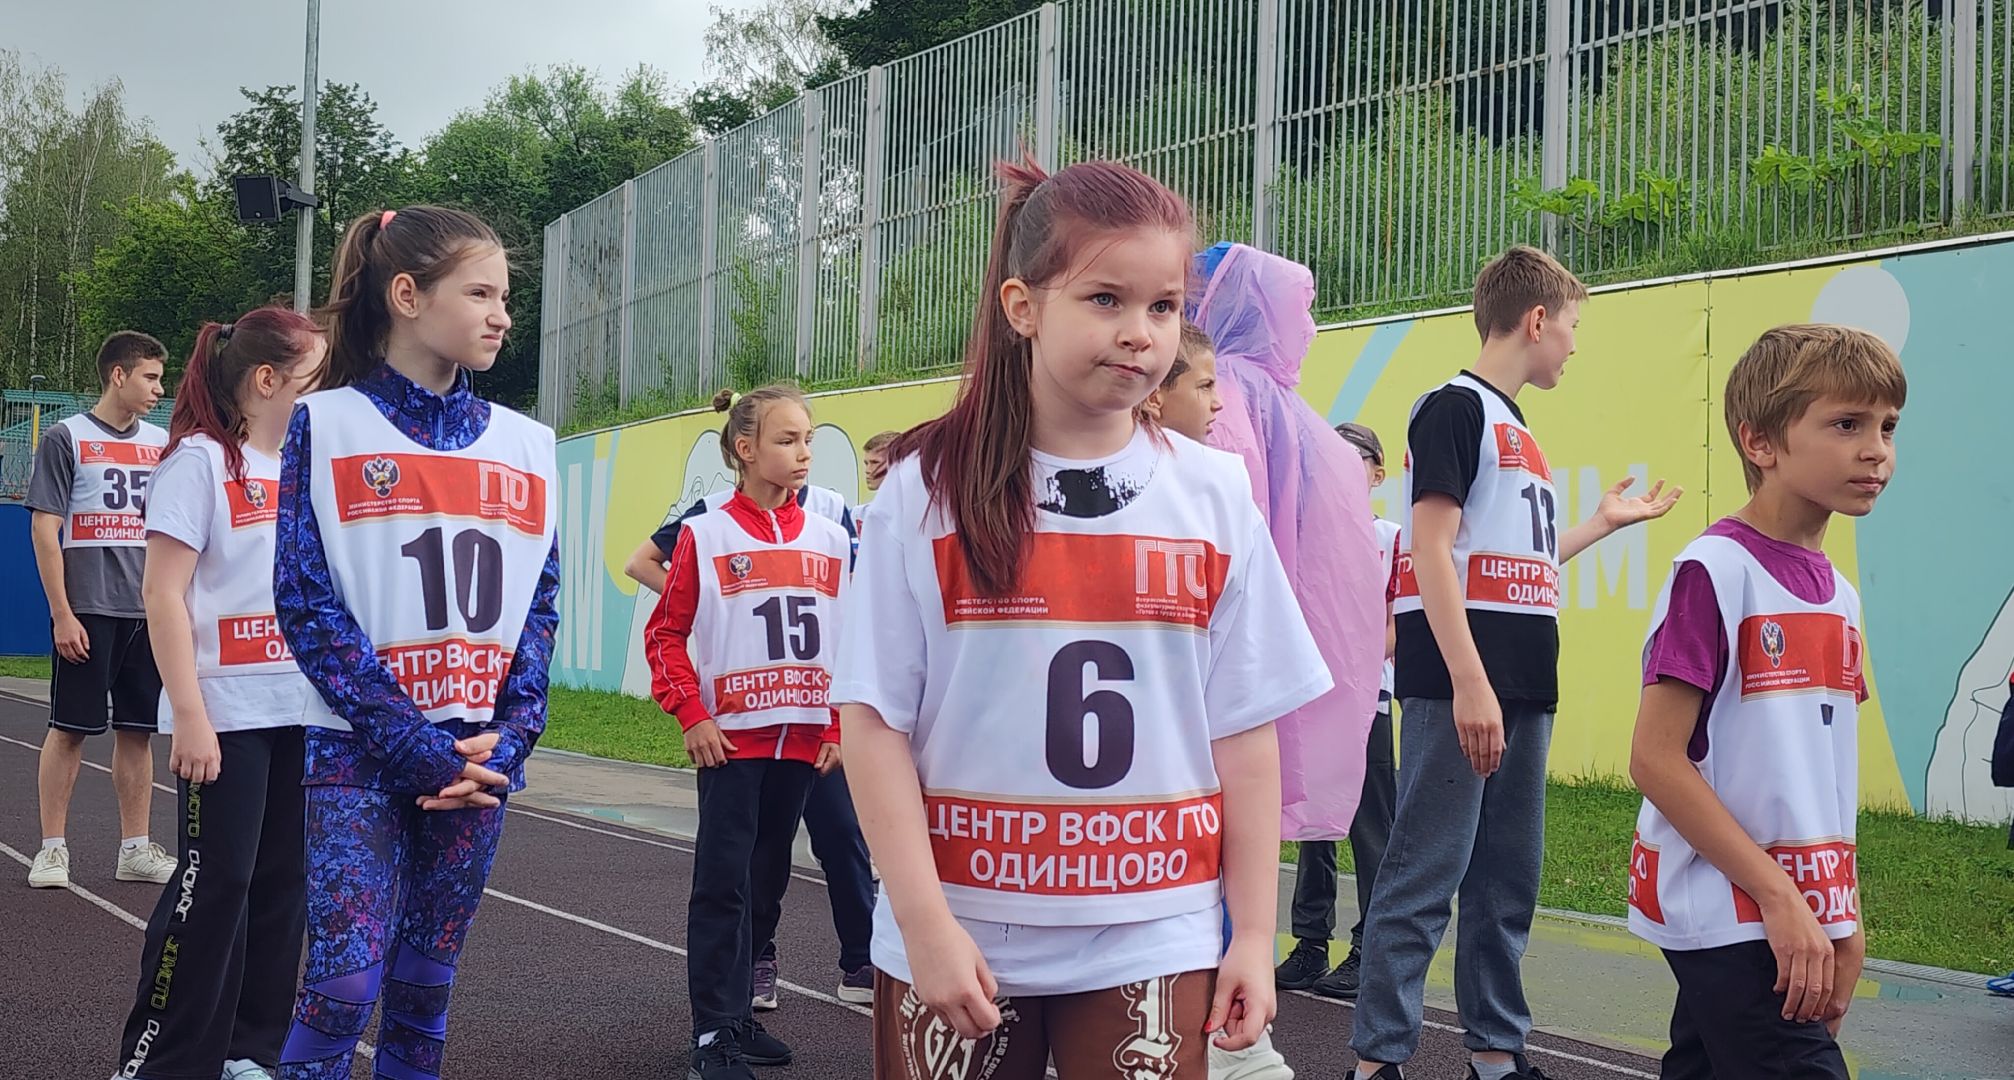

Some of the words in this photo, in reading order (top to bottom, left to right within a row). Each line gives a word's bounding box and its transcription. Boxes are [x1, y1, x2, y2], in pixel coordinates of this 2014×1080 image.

[478, 462, 529, 511] ГТО
[79, 515, 120, 528] ЦЕНТР
[1521, 482, 1556, 560] 13
[401, 527, 503, 633] 10
[1135, 539, 1207, 600] ГТО
[1481, 558, 1541, 582] ЦЕНТР
[997, 606, 1049, 614] ФЕДЕРАЦИИ
[1011, 596, 1045, 604] СПОРТА
[752, 595, 820, 661] 15
[1045, 639, 1135, 790] 6
[1058, 809, 1167, 847] ВФСК
[1176, 802, 1219, 840] ГТО
[970, 848, 1188, 891] ОДИНЦОВО
